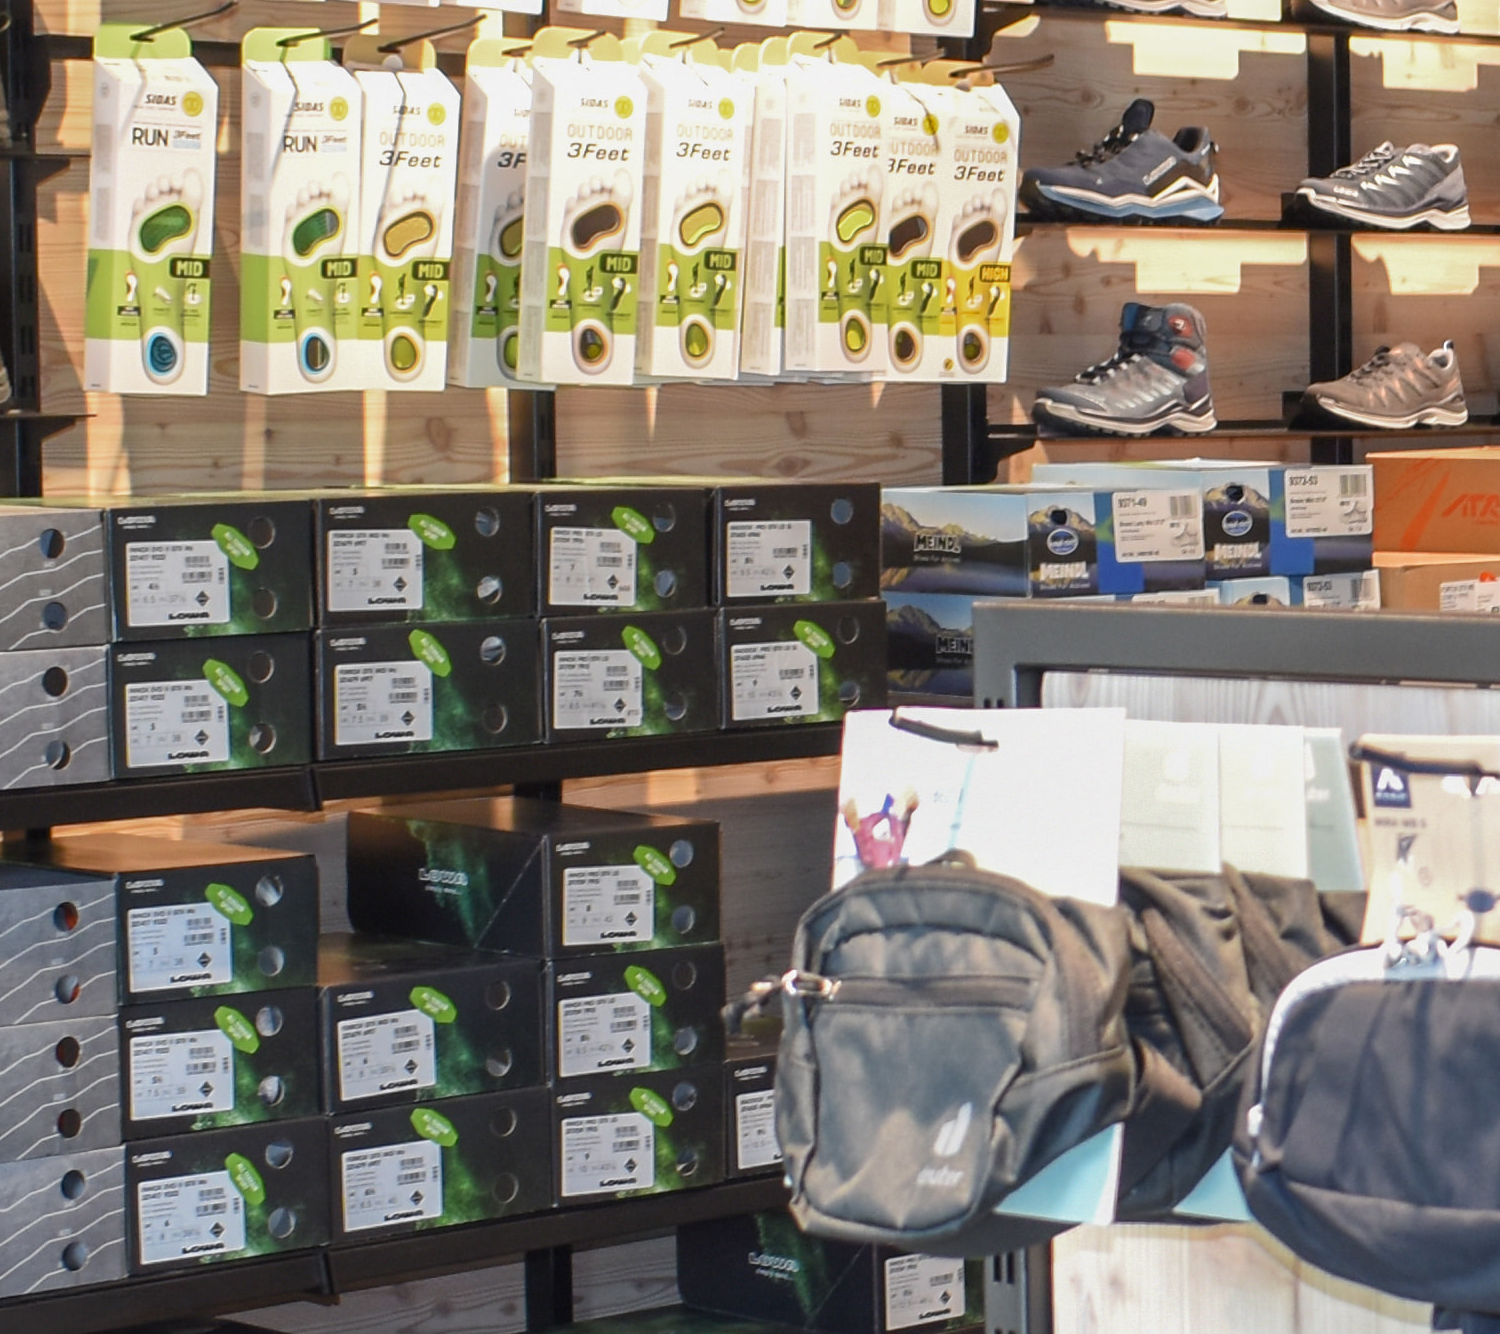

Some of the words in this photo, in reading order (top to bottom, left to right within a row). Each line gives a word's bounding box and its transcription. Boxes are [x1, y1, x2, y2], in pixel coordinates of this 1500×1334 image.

[131, 127, 169, 148] RUN
[282, 134, 317, 154] RUN
[566, 141, 630, 163] 3Feet
[675, 141, 732, 163] 3Feet
[830, 139, 879, 159] 3Feet
[379, 149, 442, 169] 3Feet
[954, 165, 1005, 183] 3Feet
[605, 255, 632, 272] MID
[709, 252, 732, 269] MID
[864, 248, 885, 265] MID
[176, 259, 204, 277] MID
[327, 259, 353, 277] MID
[418, 262, 444, 279] MID
[916, 261, 938, 278] MID
[982, 265, 1009, 281] HIGH
[913, 533, 962, 554] MEINDL
[1214, 541, 1263, 559] MEINDL
[1040, 560, 1090, 581] MEINDL
[368, 596, 406, 605] LOWA
[168, 611, 209, 620] LOWA
[936, 634, 974, 655] MEIN
[375, 730, 414, 740] LOWA
[168, 750, 209, 760] LOWA
[418, 868, 469, 886] LOWA
[170, 972, 212, 983] LOWA
[379, 1079, 419, 1091] LOWA
[172, 1102, 213, 1113] LOWA
[384, 1209, 424, 1222] LOWA
[182, 1242, 225, 1255] LOWA
